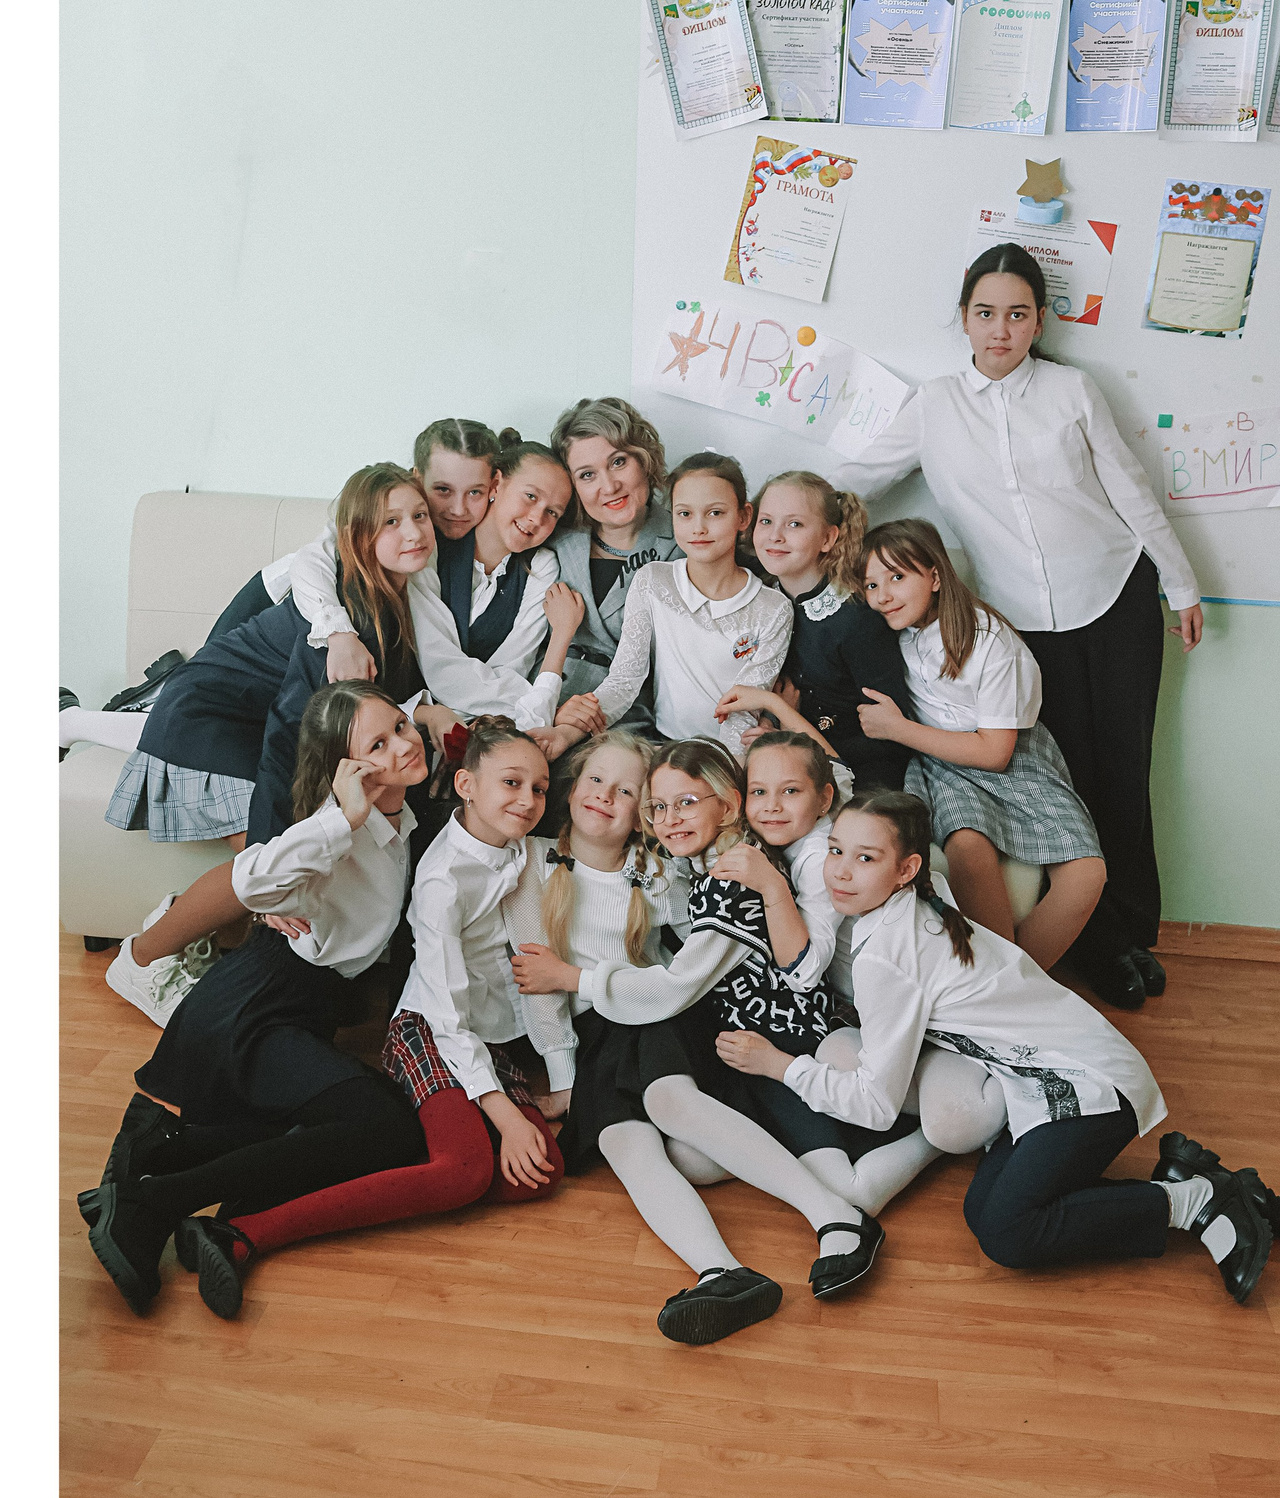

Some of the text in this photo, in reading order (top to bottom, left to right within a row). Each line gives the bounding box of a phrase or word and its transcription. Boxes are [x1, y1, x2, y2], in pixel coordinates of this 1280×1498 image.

[1089, 1, 1143, 9] Сертификат
[880, 7, 924, 15] участника
[979, 6, 1051, 20] ГОРОШИНА
[761, 13, 830, 23] Сертификат участника
[681, 16, 727, 36] ДИПЛОМ
[993, 22, 1023, 31] Диплом
[1195, 27, 1244, 38] ДИПЛОМ
[776, 179, 834, 204] ГРАМОТА
[1045, 257, 1074, 267] СТЕПЕНИ
